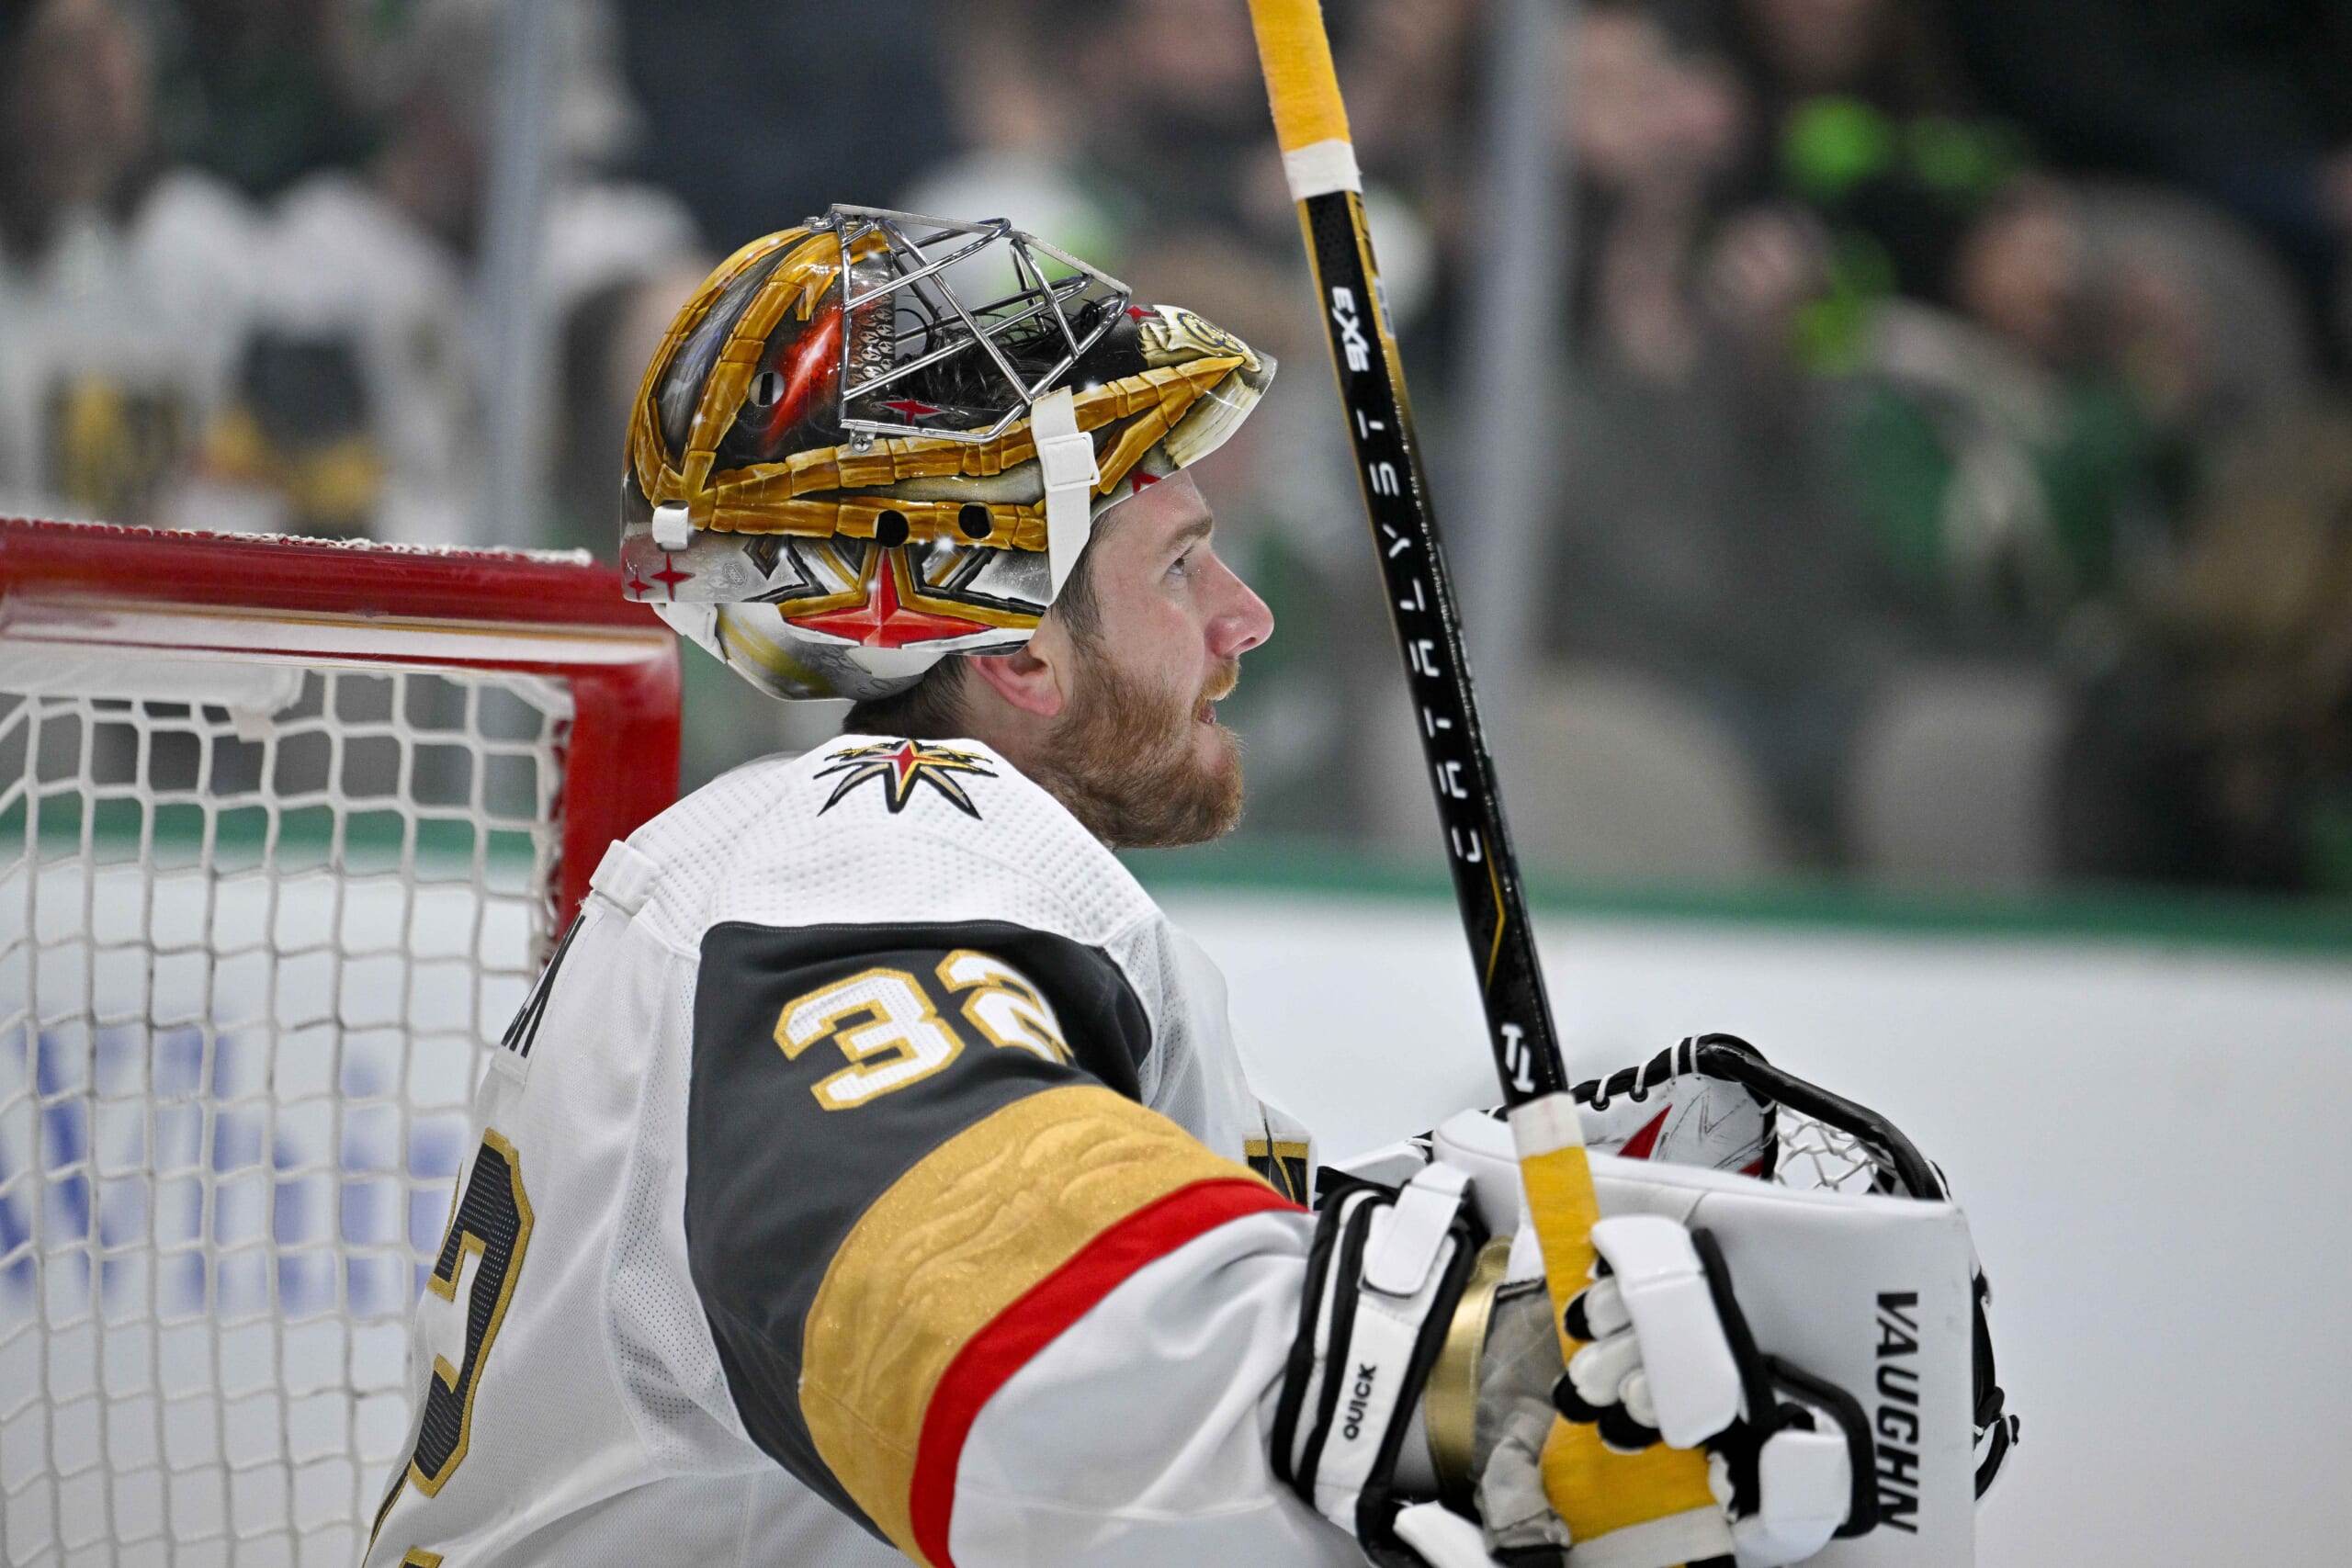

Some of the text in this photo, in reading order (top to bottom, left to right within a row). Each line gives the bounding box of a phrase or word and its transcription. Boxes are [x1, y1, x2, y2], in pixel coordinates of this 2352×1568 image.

[1357, 409, 1483, 863] CATALYST
[774, 949, 1074, 1111] 32
[1342, 1363, 1377, 1441] QUICK
[1875, 1291, 1919, 1535] VAUGHN
